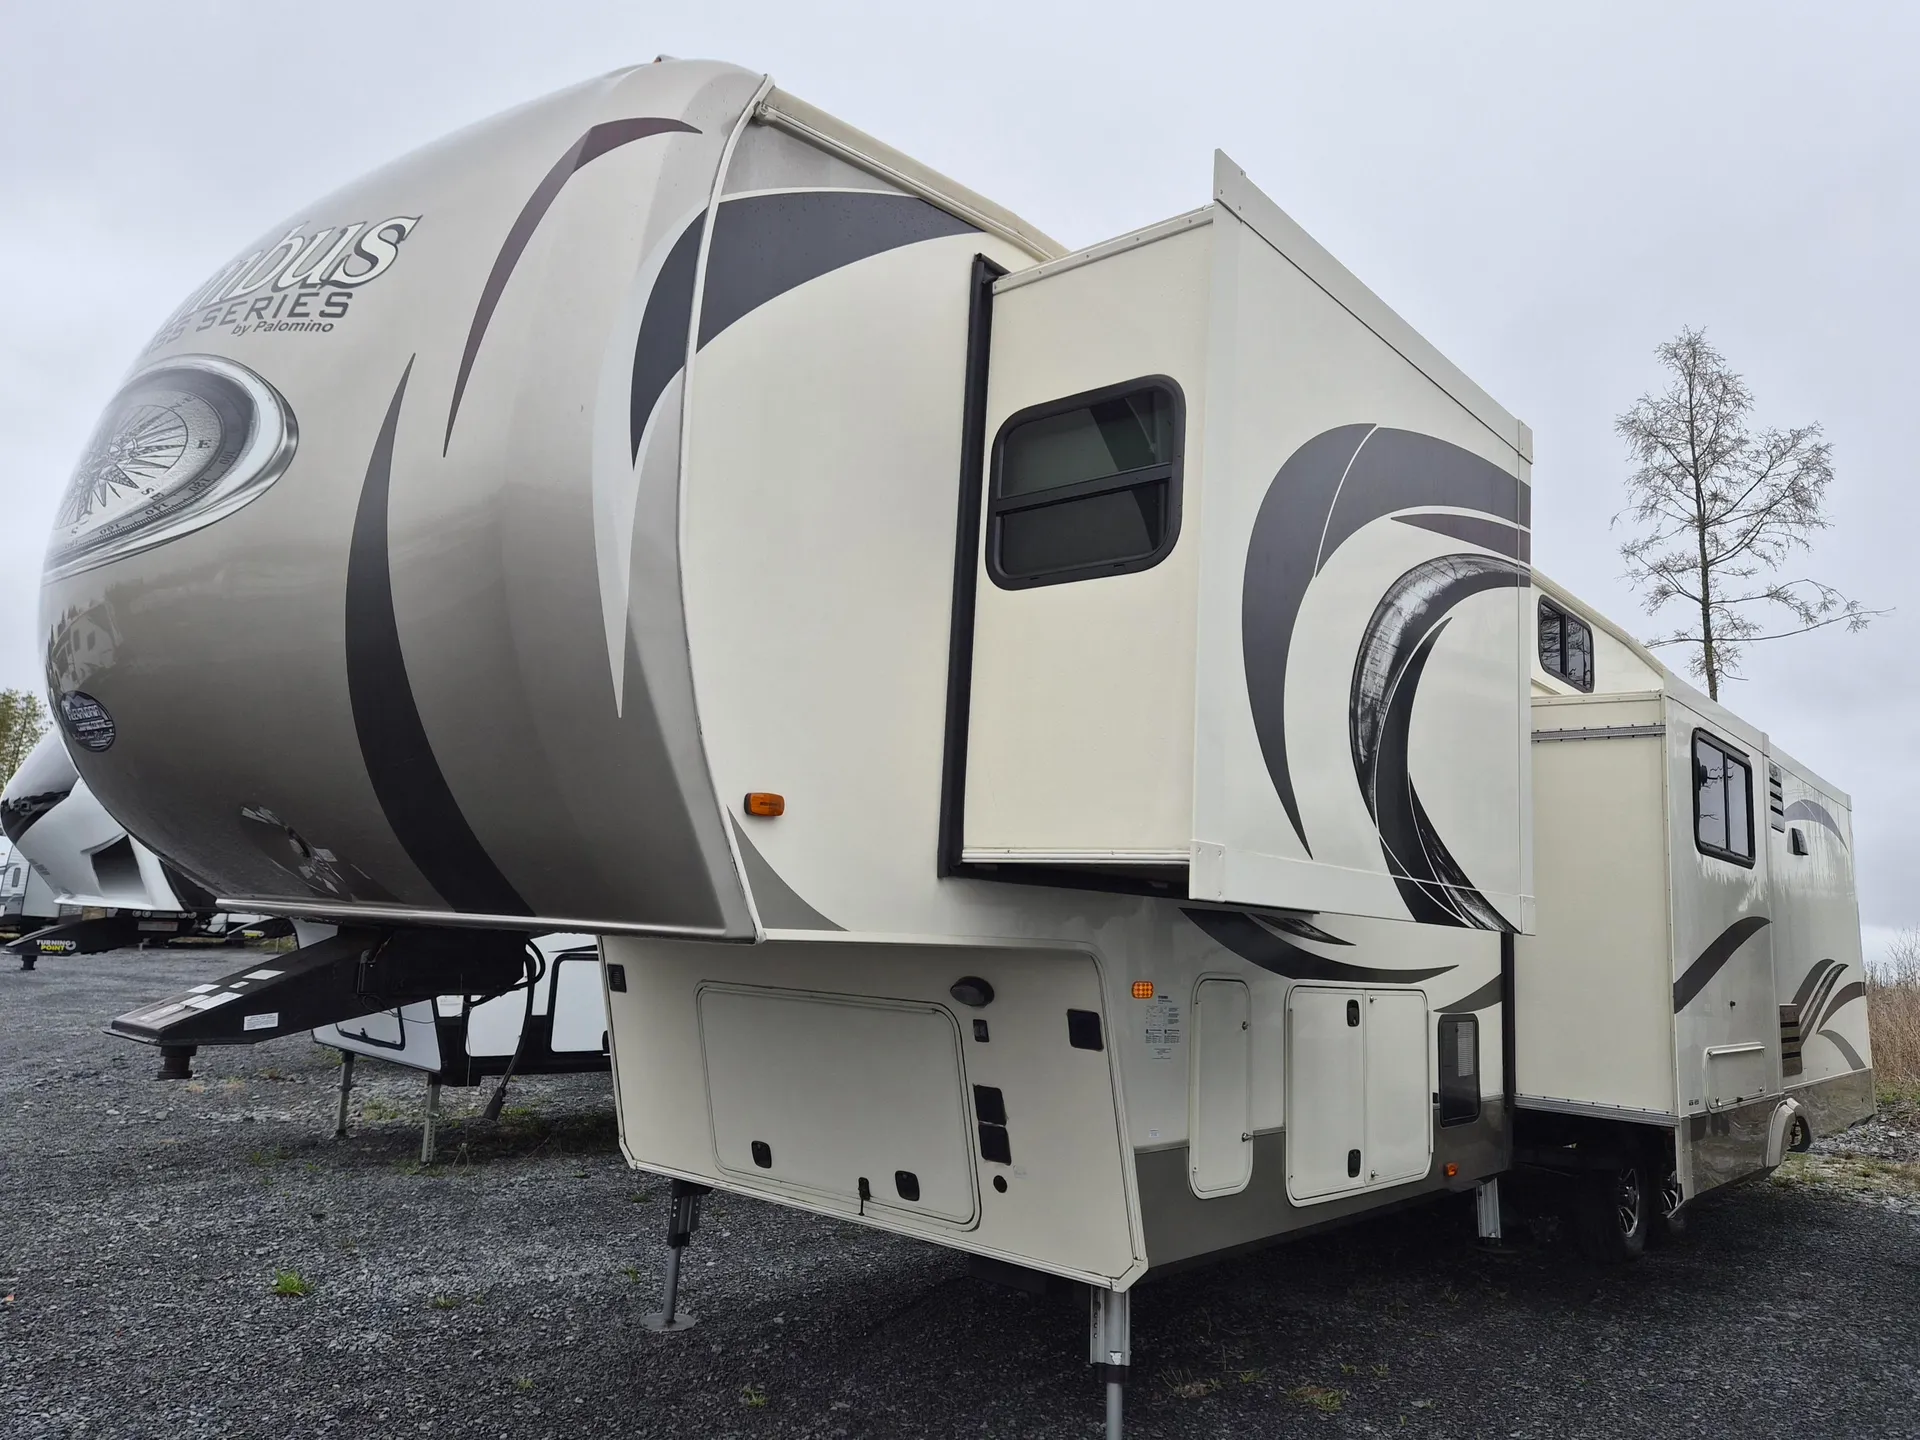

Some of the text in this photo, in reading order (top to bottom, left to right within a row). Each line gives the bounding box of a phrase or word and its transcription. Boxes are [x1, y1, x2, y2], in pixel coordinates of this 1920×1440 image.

[195, 291, 354, 333] SERIES
[230, 319, 335, 337] by Palomino
[196, 439, 212, 449] E
[36, 939, 74, 947] TURNING
